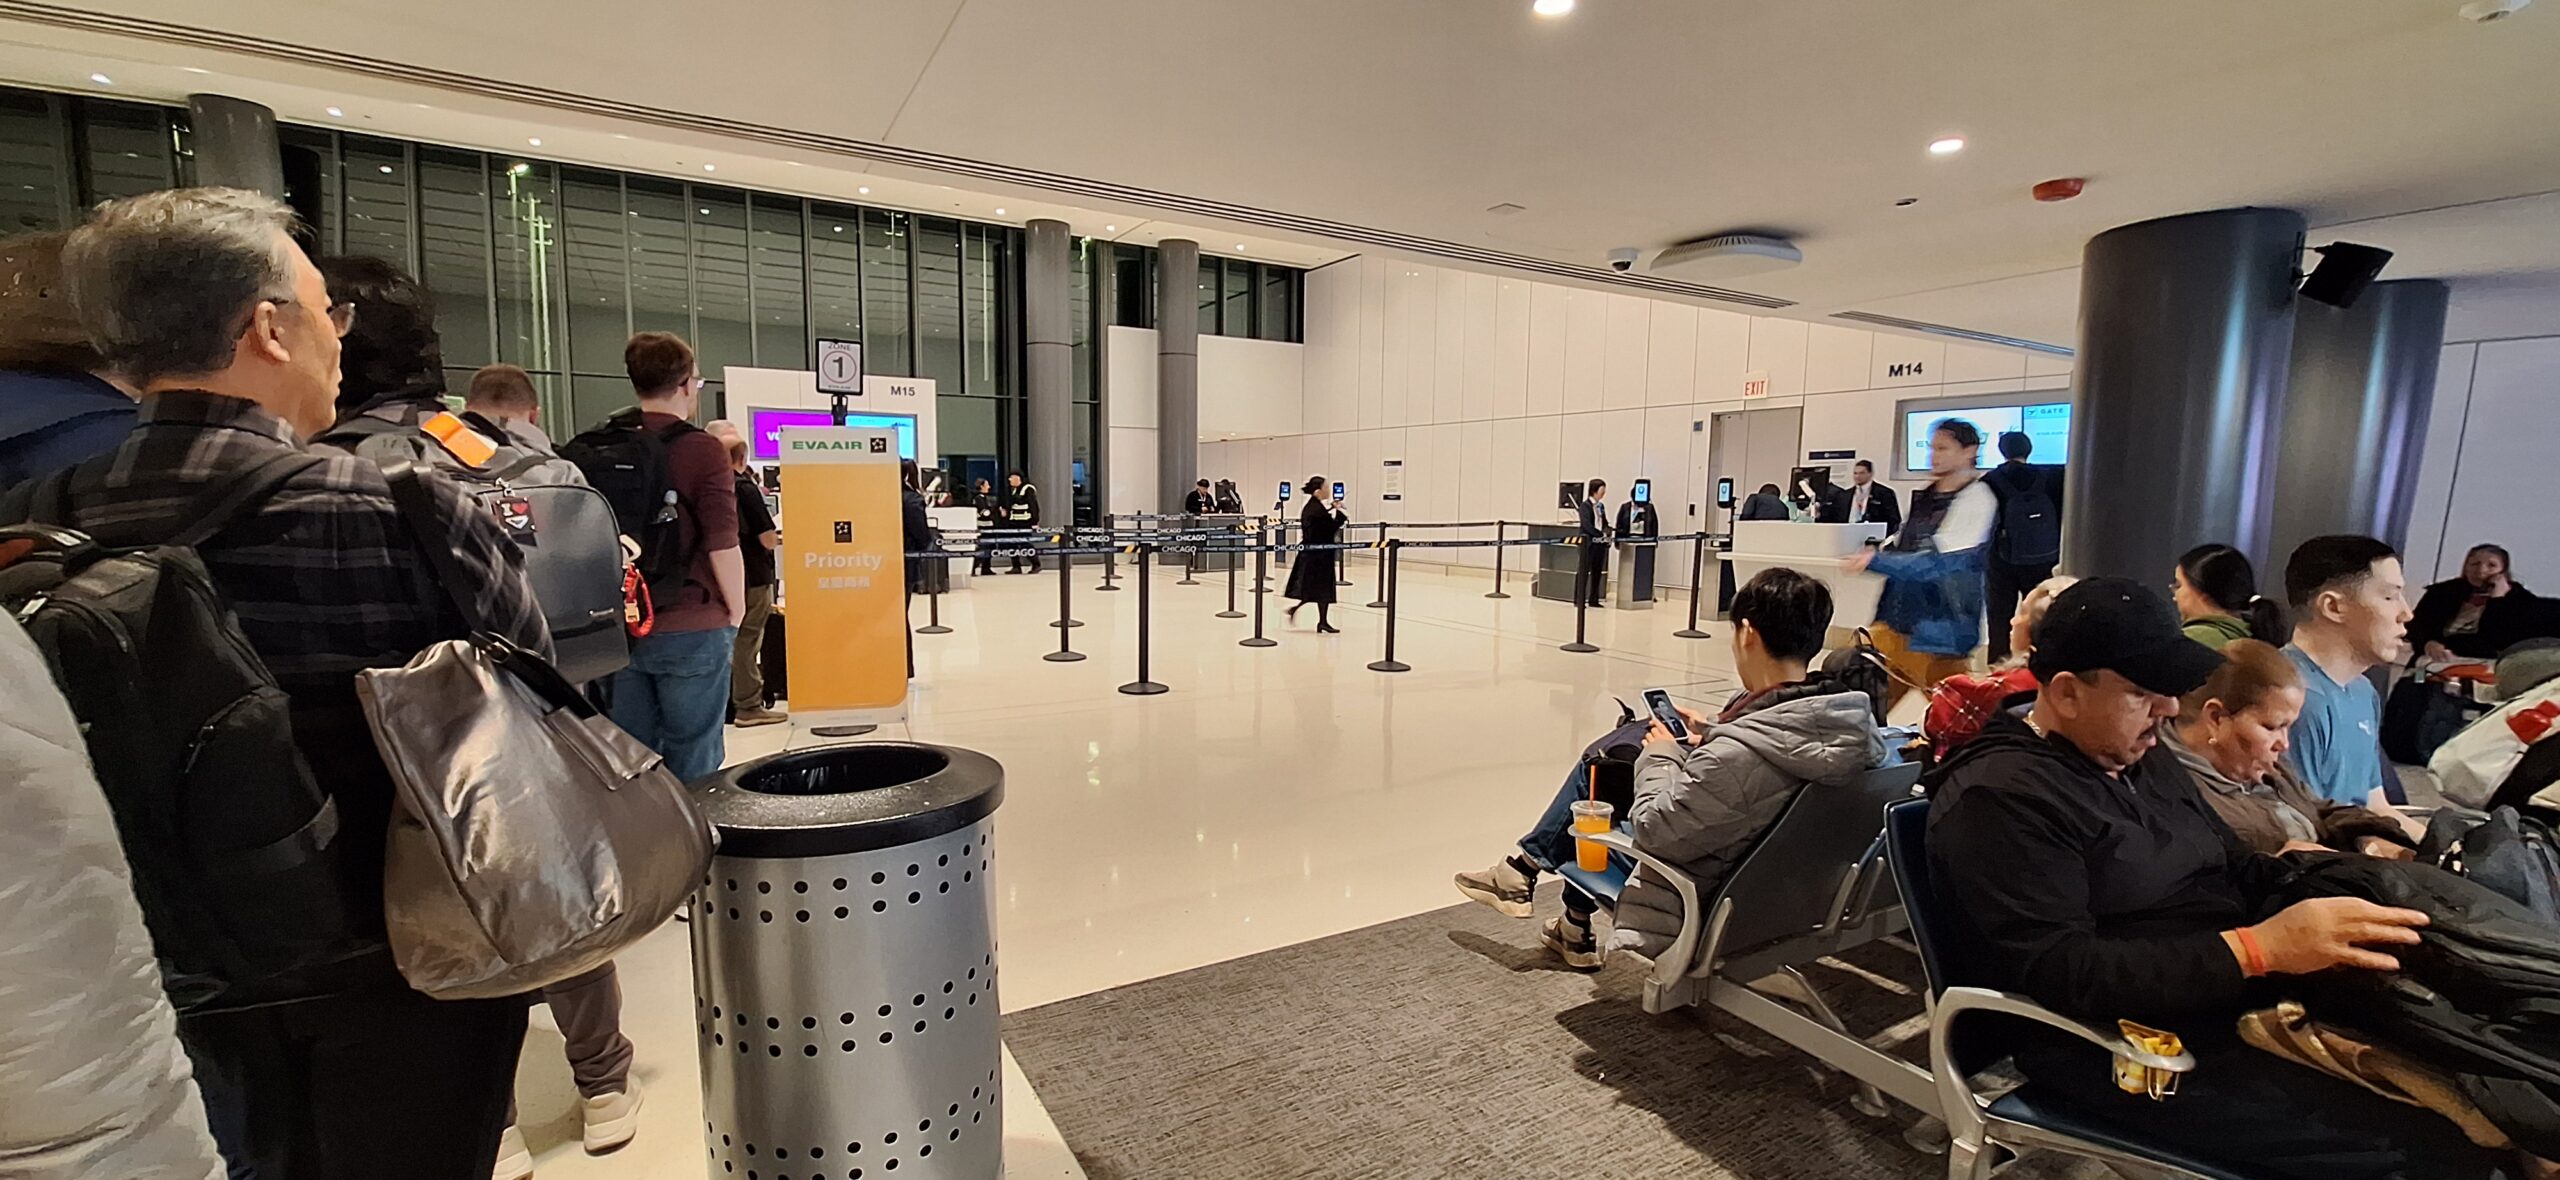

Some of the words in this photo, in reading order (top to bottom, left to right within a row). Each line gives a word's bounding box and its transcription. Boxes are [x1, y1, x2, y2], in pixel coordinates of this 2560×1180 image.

[832, 356, 843, 378] 1
[1888, 362, 1923, 377] M14
[890, 386, 916, 397] M15
[1744, 380, 1766, 396] EXIT
[792, 441, 829, 450] EVA
[831, 441, 863, 450] AIR
[991, 548, 1036, 557] CHICAGO
[1161, 545, 1197, 553] CHICAGO
[804, 551, 883, 571] Priority
